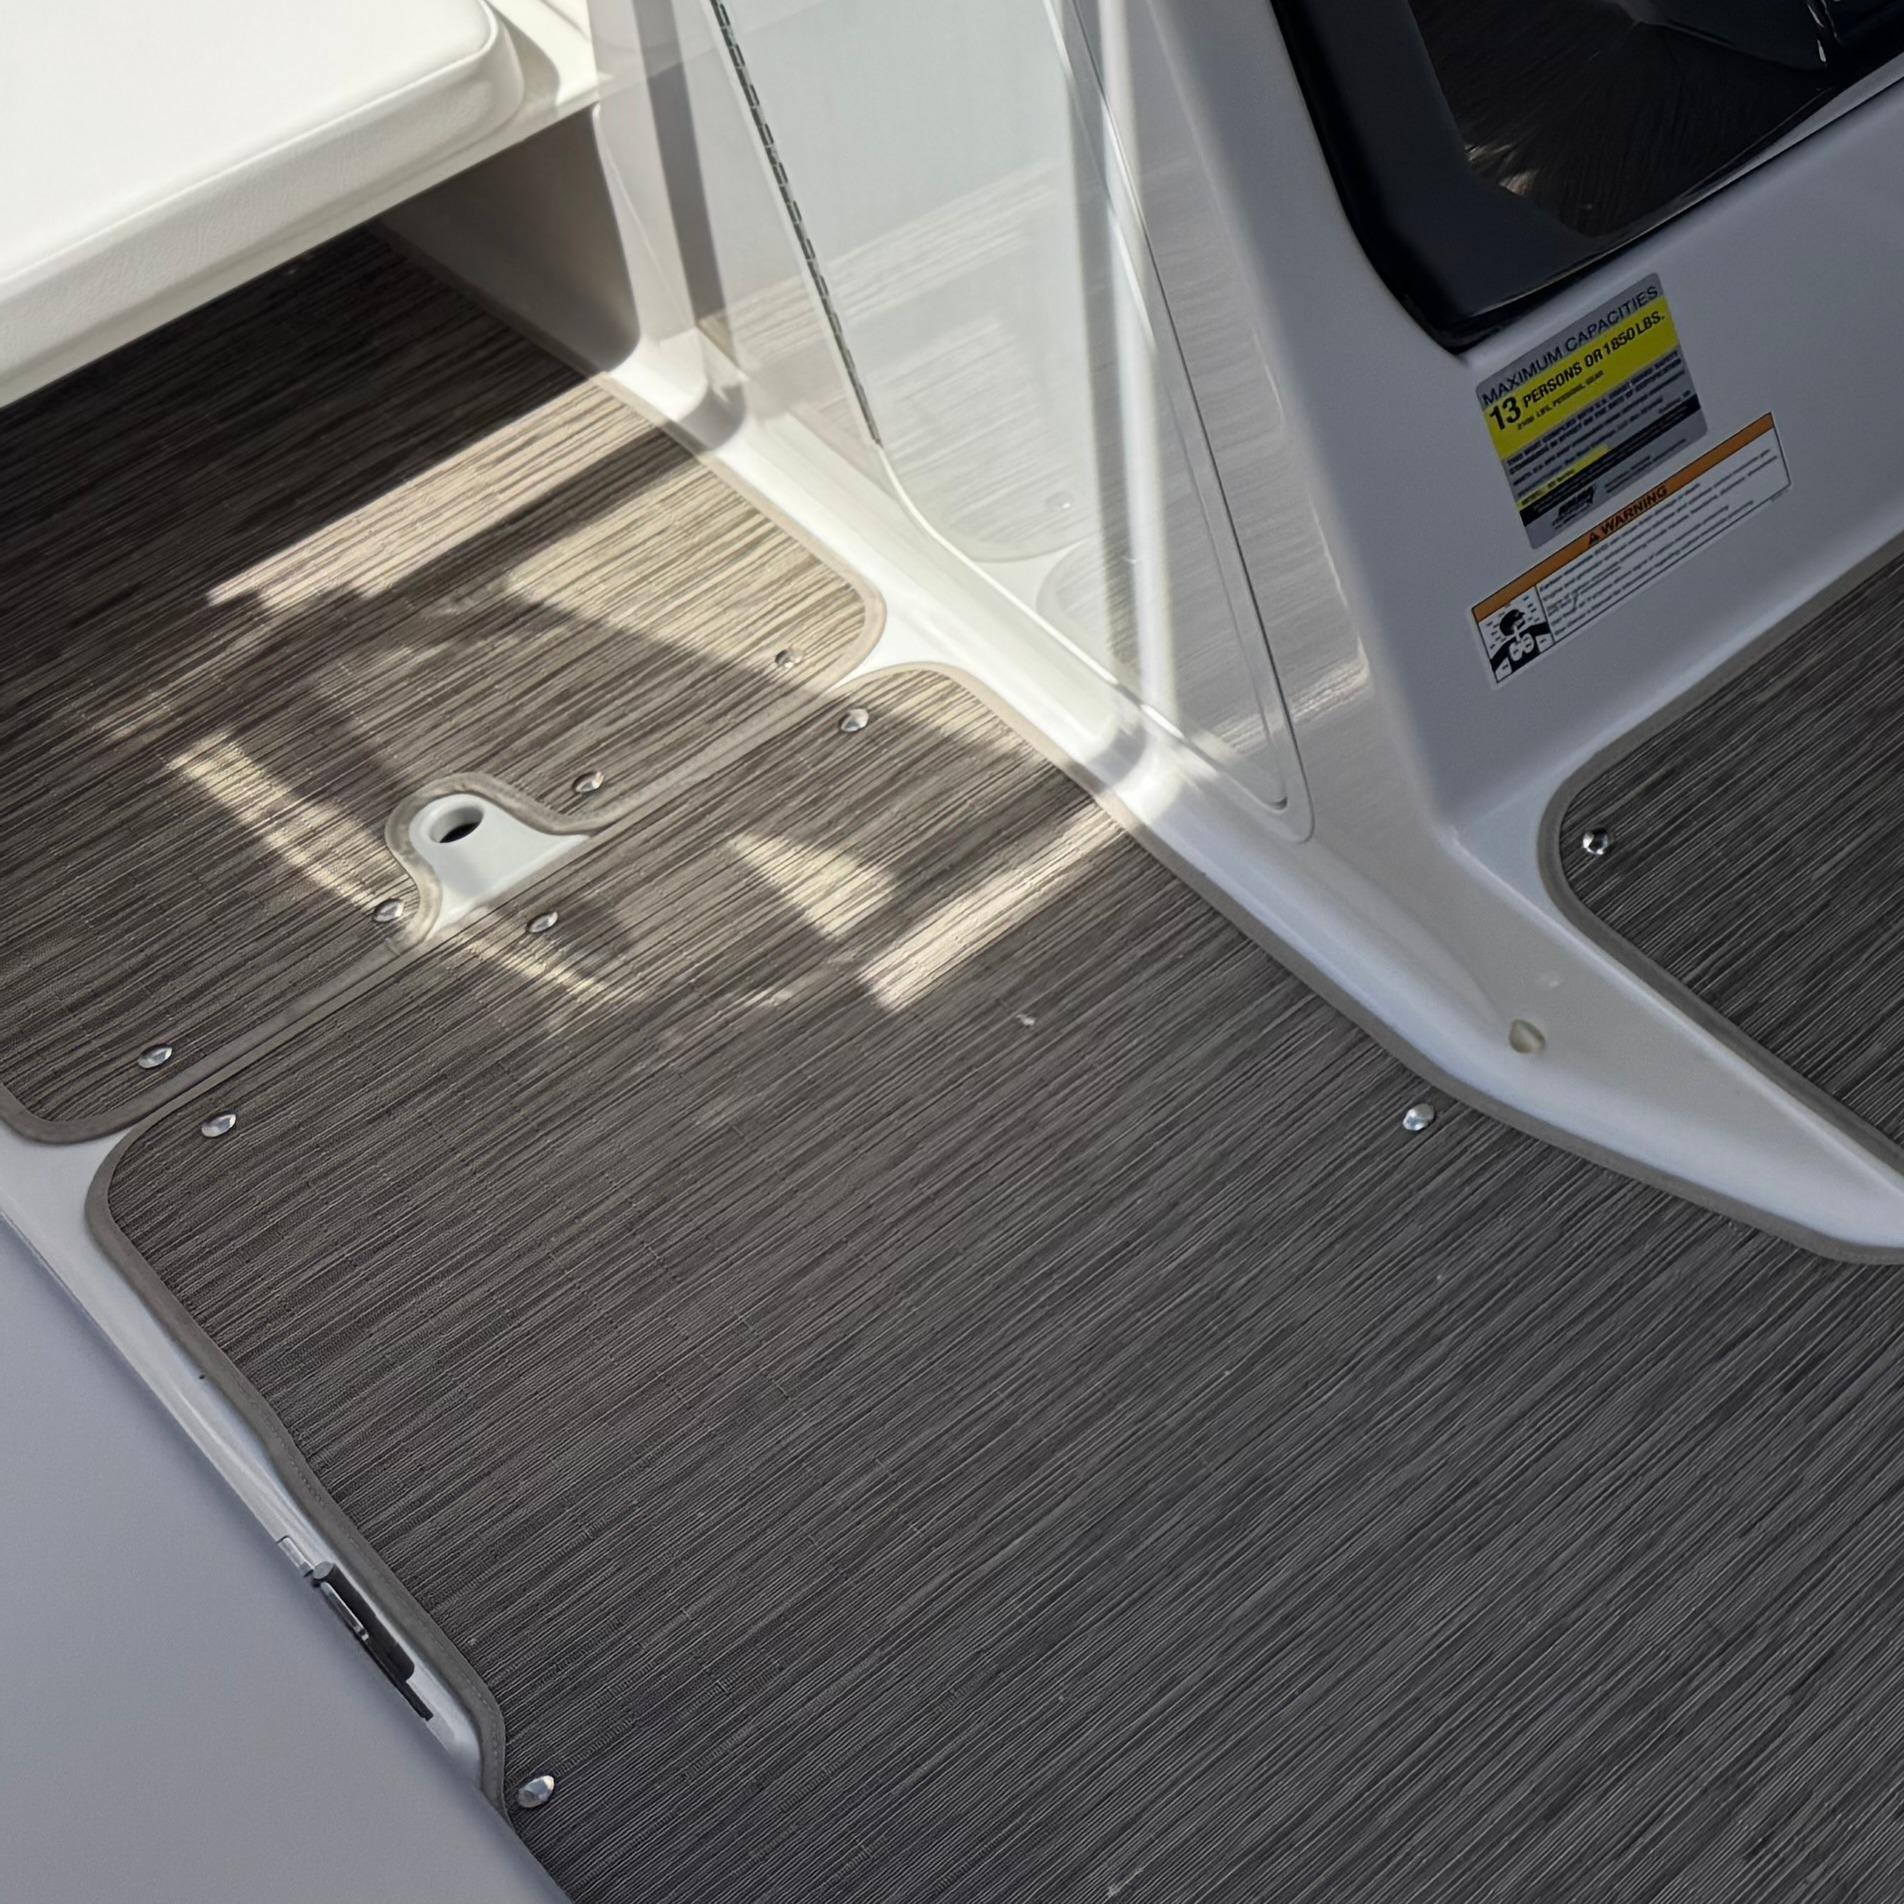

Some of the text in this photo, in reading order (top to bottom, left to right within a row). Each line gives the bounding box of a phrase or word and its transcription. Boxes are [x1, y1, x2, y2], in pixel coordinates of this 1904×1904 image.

[1483, 347, 1566, 405] MAXIMUM
[1564, 285, 1658, 353] CAPACITIES
[1489, 396, 1521, 431] 13
[1523, 361, 1582, 409] PERSONS
[1585, 349, 1603, 367] OR
[1603, 327, 1635, 356] 1850
[1636, 310, 1665, 336] LBS.
[1601, 485, 1667, 534] WARNING
